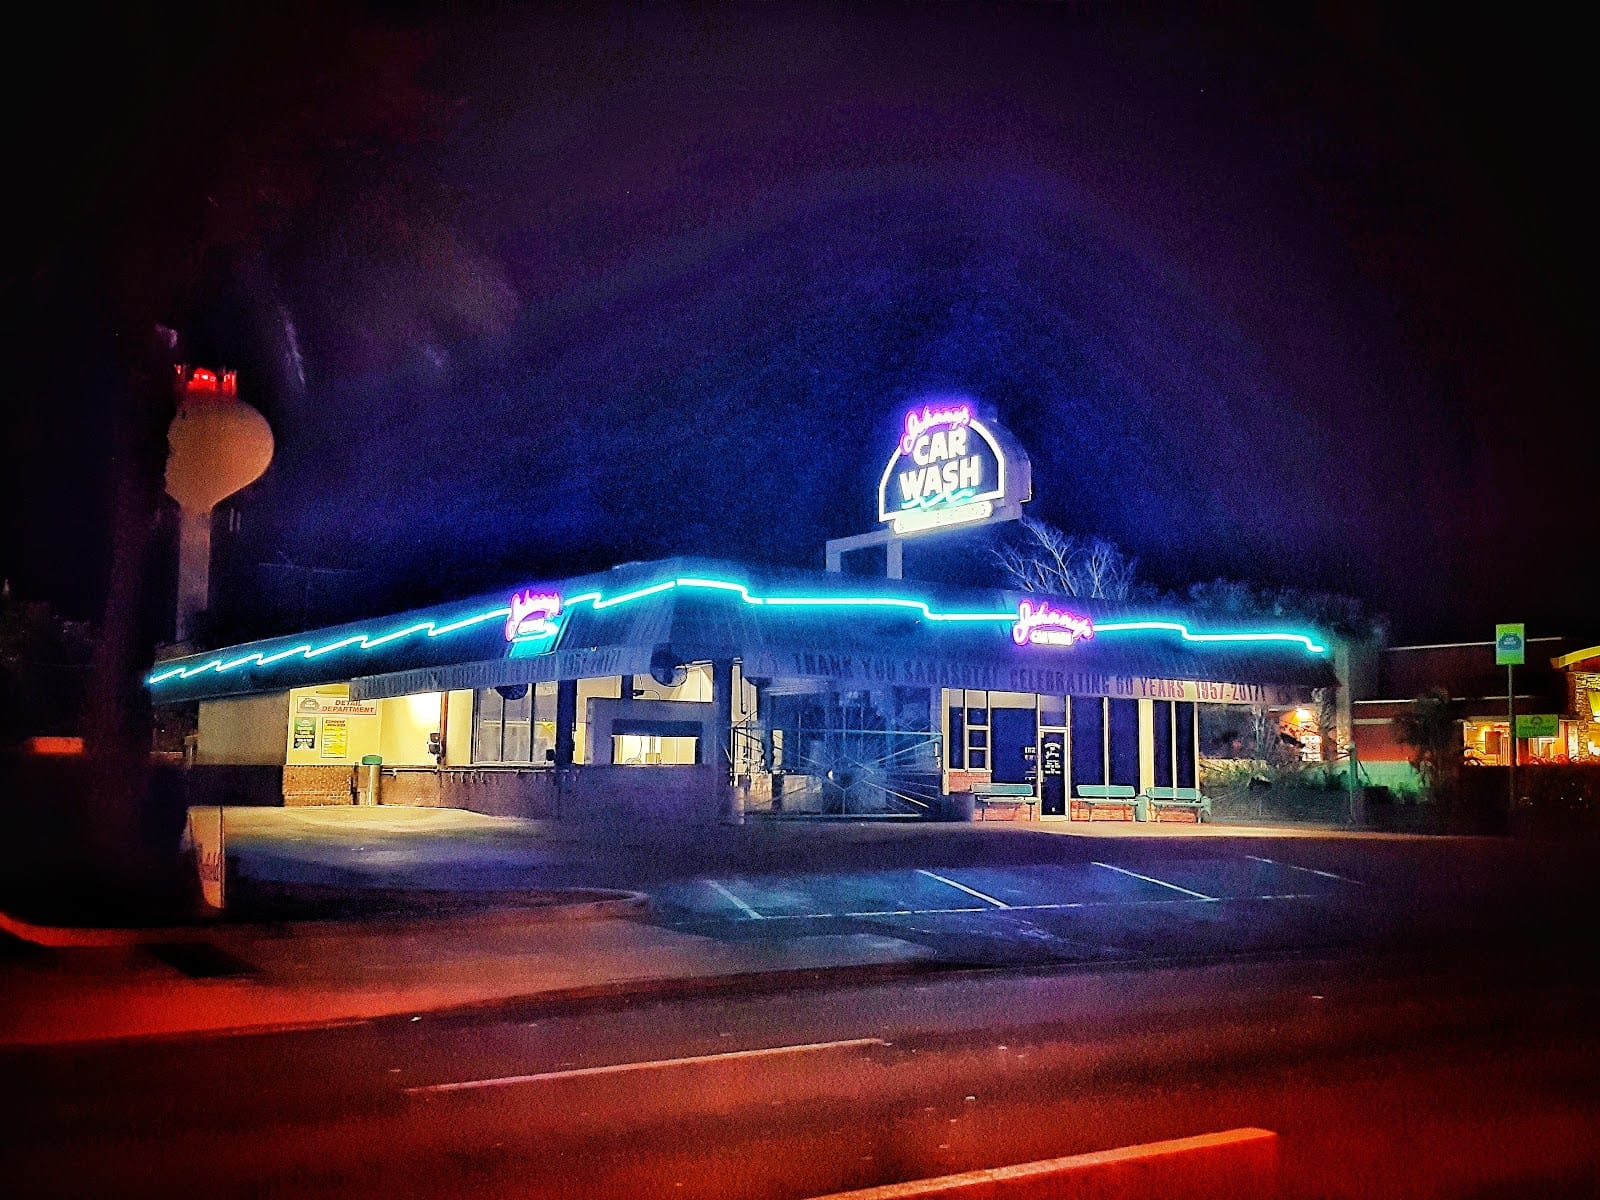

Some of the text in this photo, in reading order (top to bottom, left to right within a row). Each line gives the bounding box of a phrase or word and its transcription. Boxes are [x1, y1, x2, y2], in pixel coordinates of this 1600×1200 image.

[913, 427, 967, 466] CAR
[900, 456, 980, 501] WASH
[862, 656, 897, 682] YOU
[1010, 668, 1109, 694] CELEBRATING
[1140, 677, 1184, 699] YEARS
